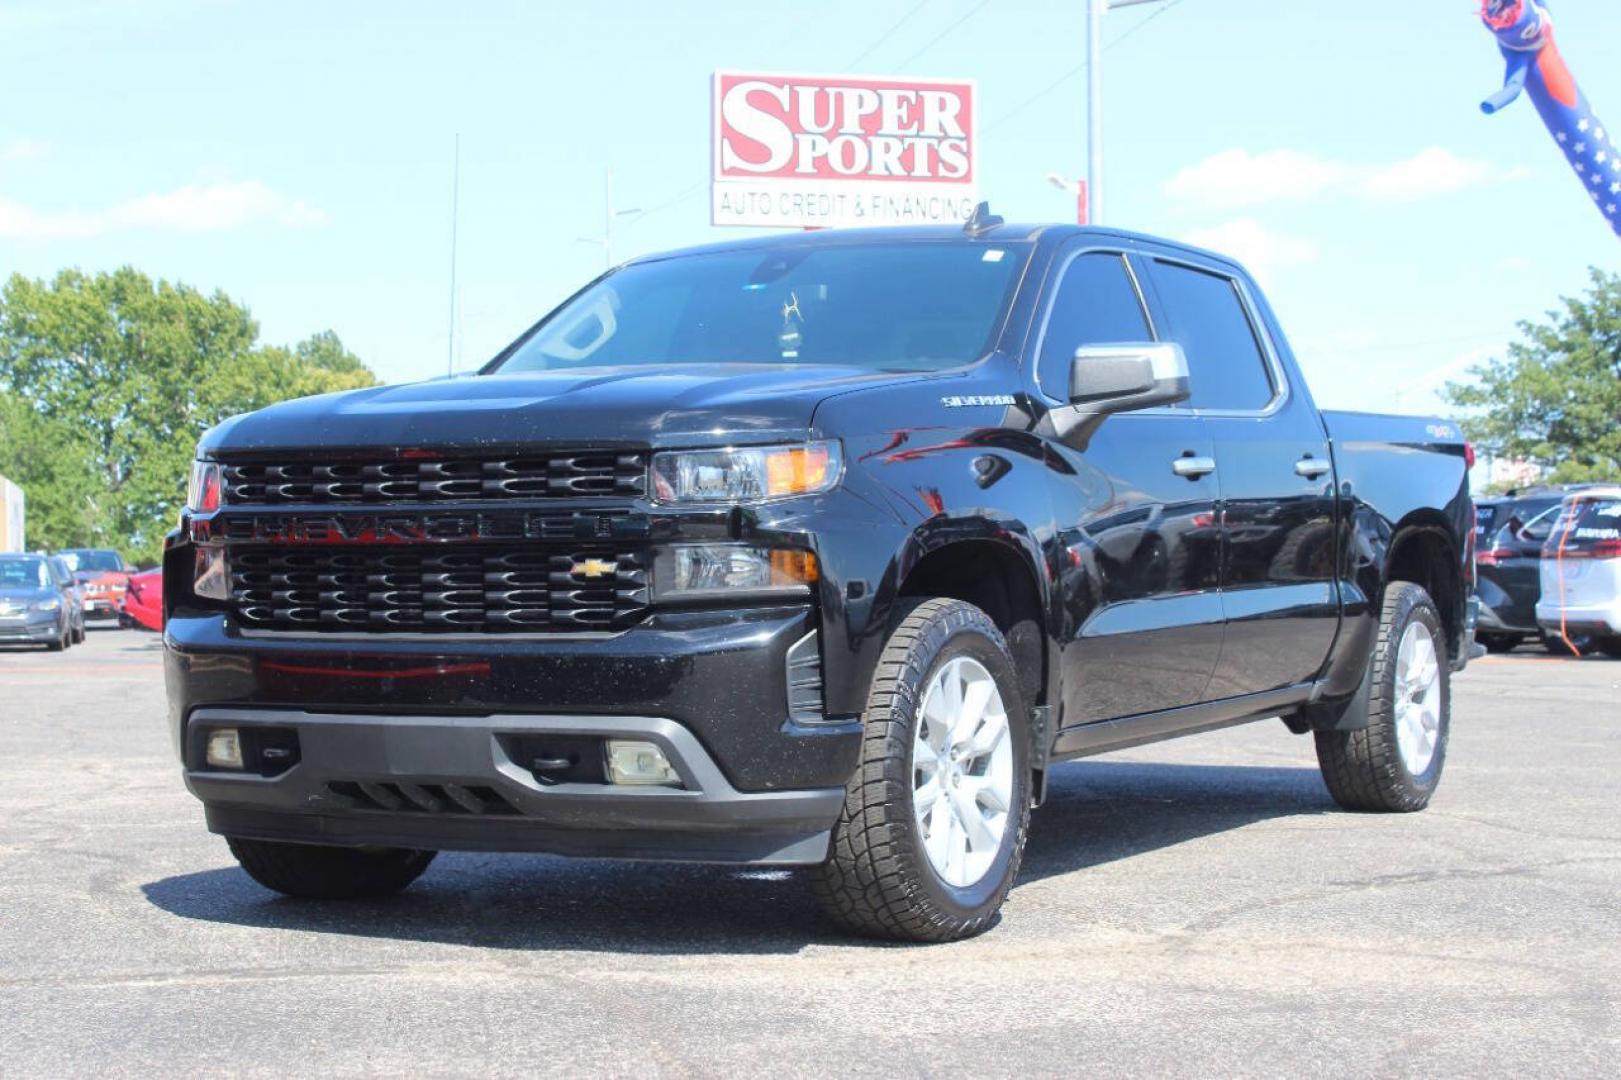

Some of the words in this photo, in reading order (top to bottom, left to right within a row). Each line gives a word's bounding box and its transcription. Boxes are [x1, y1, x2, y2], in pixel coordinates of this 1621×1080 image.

[720, 192, 771, 216] AUTO
[779, 192, 848, 218] CREDIT
[854, 193, 866, 218] &
[871, 194, 974, 221] FINANCING
